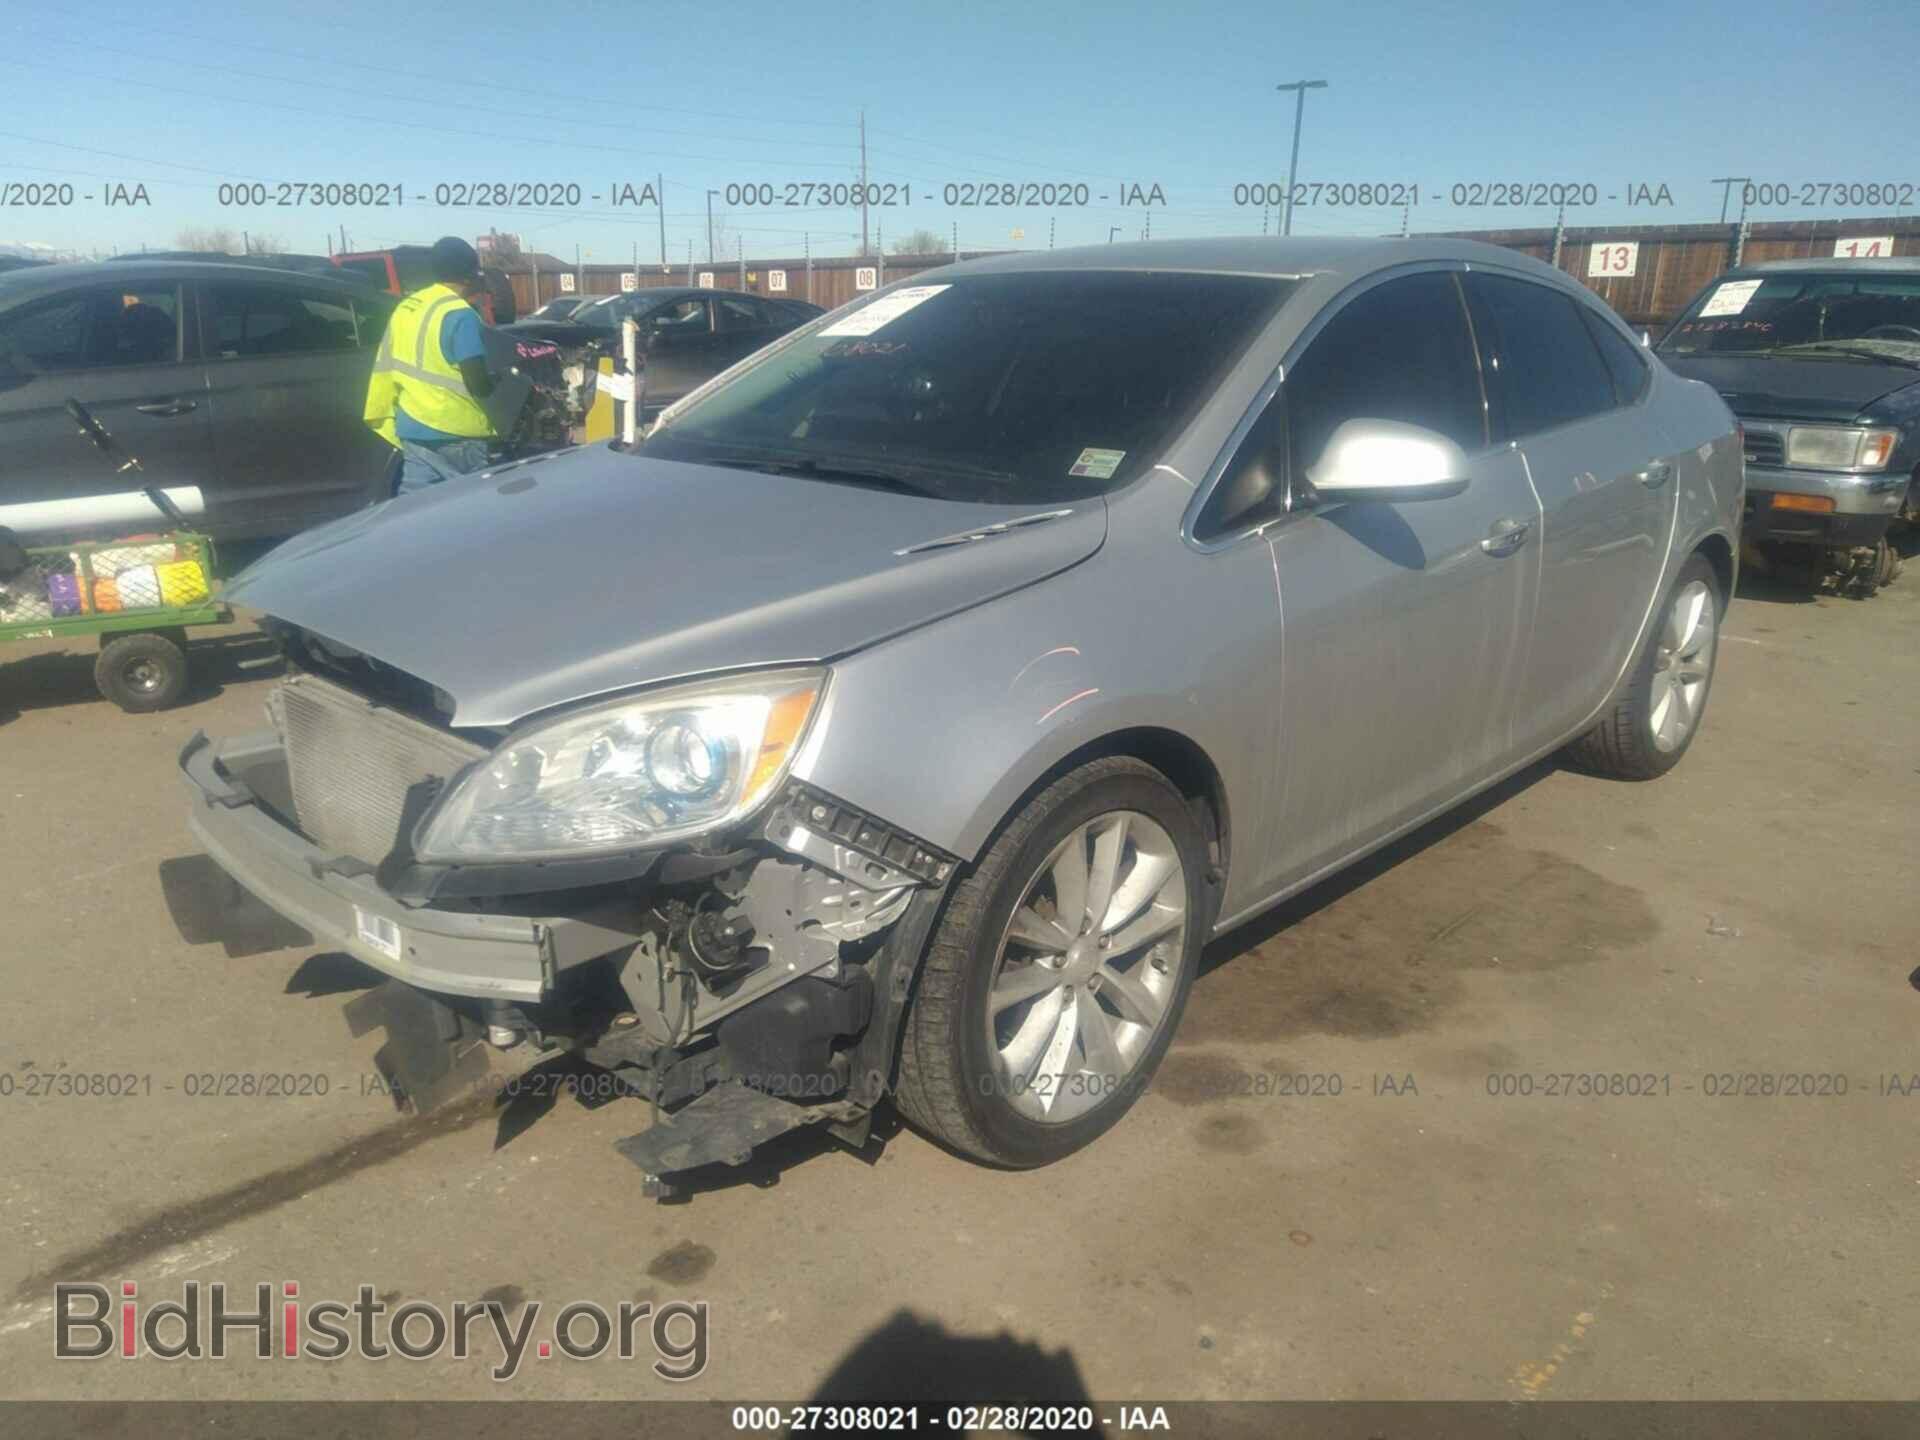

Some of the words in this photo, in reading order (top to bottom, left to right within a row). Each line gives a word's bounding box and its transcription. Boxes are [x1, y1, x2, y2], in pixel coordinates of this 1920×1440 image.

[1600, 246, 1630, 271] 13
[770, 271, 784, 287] 07
[858, 270, 873, 286] 08
